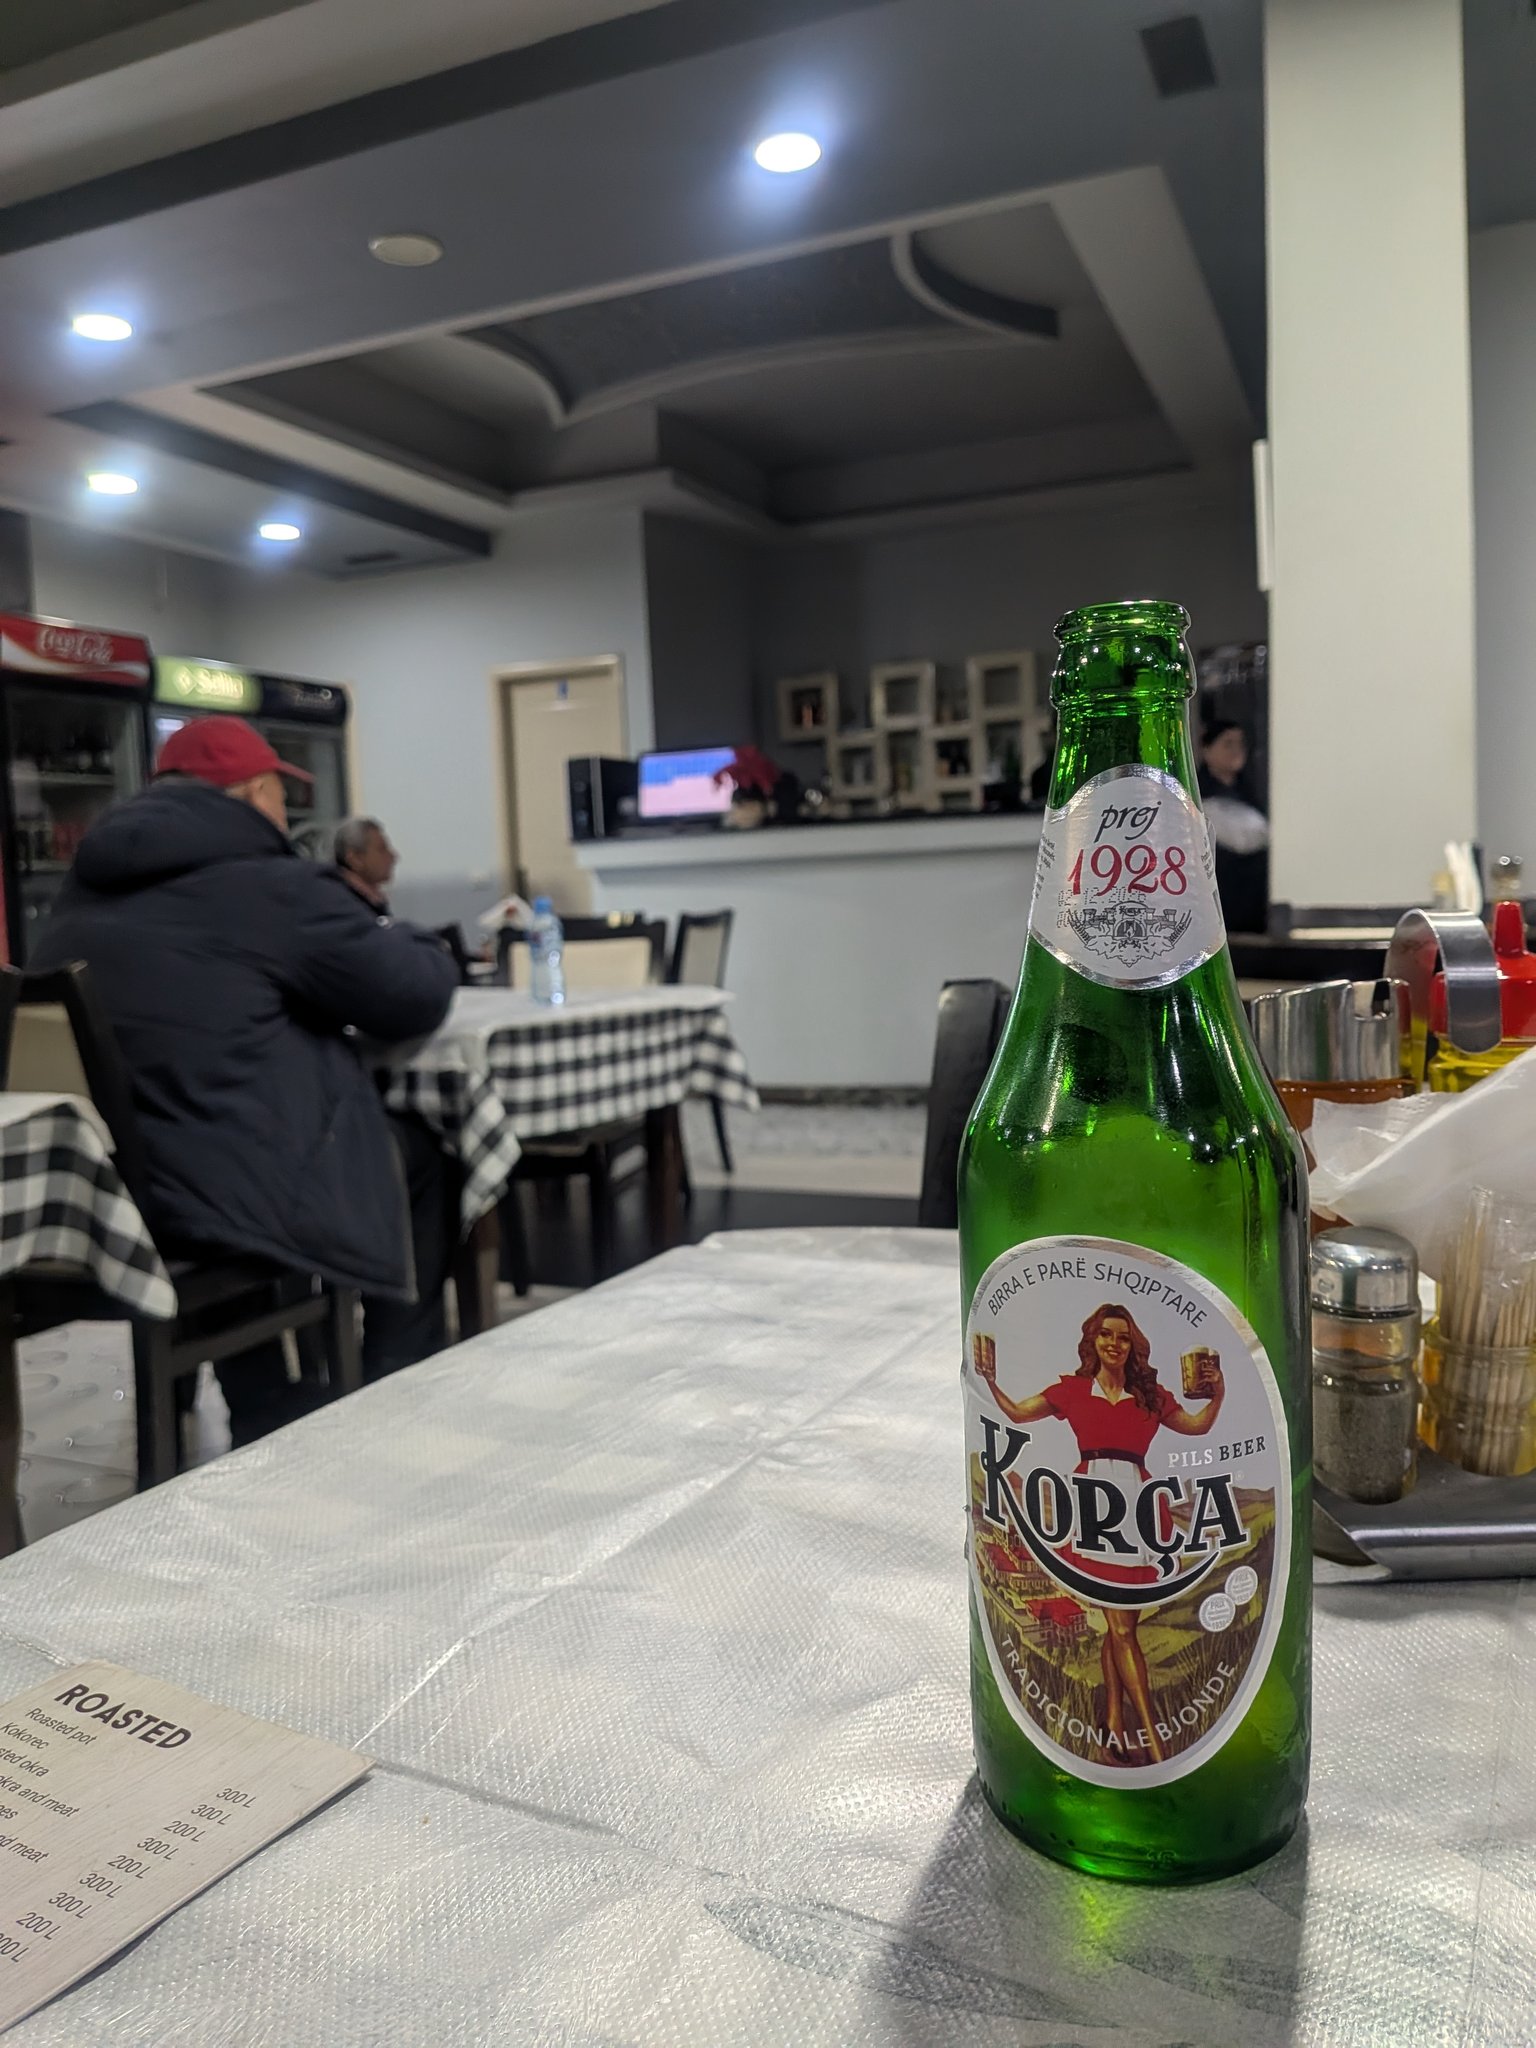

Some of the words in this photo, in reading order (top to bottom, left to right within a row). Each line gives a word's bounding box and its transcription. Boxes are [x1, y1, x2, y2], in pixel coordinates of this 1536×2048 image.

[1094, 801, 1162, 843] prej
[1067, 844, 1187, 896] 1928
[988, 1276, 1024, 1316] BIRRA
[1023, 1268, 1036, 1286] E
[1037, 1257, 1087, 1281] PARË
[1094, 1263, 1207, 1328] SHQIPTARE
[1168, 1449, 1213, 1468] PILS
[1219, 1436, 1266, 1462] BEER
[980, 1415, 1248, 1604] KORÇA
[1001, 1634, 1152, 1750] TRADICIONALE
[1155, 1662, 1236, 1742] BJONDE
[25, 1707, 79, 1735] Roasted
[67, 1731, 98, 1745] pot
[54, 1684, 192, 1749] ROASTED
[0, 1722, 49, 1750] Kokorec
[19, 1761, 49, 1777] okra
[18, 1788, 50, 1803] and
[41, 1798, 81, 1817] meat
[216, 1788, 249, 1804] 300
[191, 1804, 223, 1821] 300
[163, 1820, 197, 1837] 200
[8, 1842, 49, 1863] meat
[137, 1837, 170, 1855] 300
[107, 1855, 142, 1873] 200
[79, 1873, 114, 1892] 300
[48, 1892, 84, 1912] 300
[16, 1912, 52, 1933] 200
